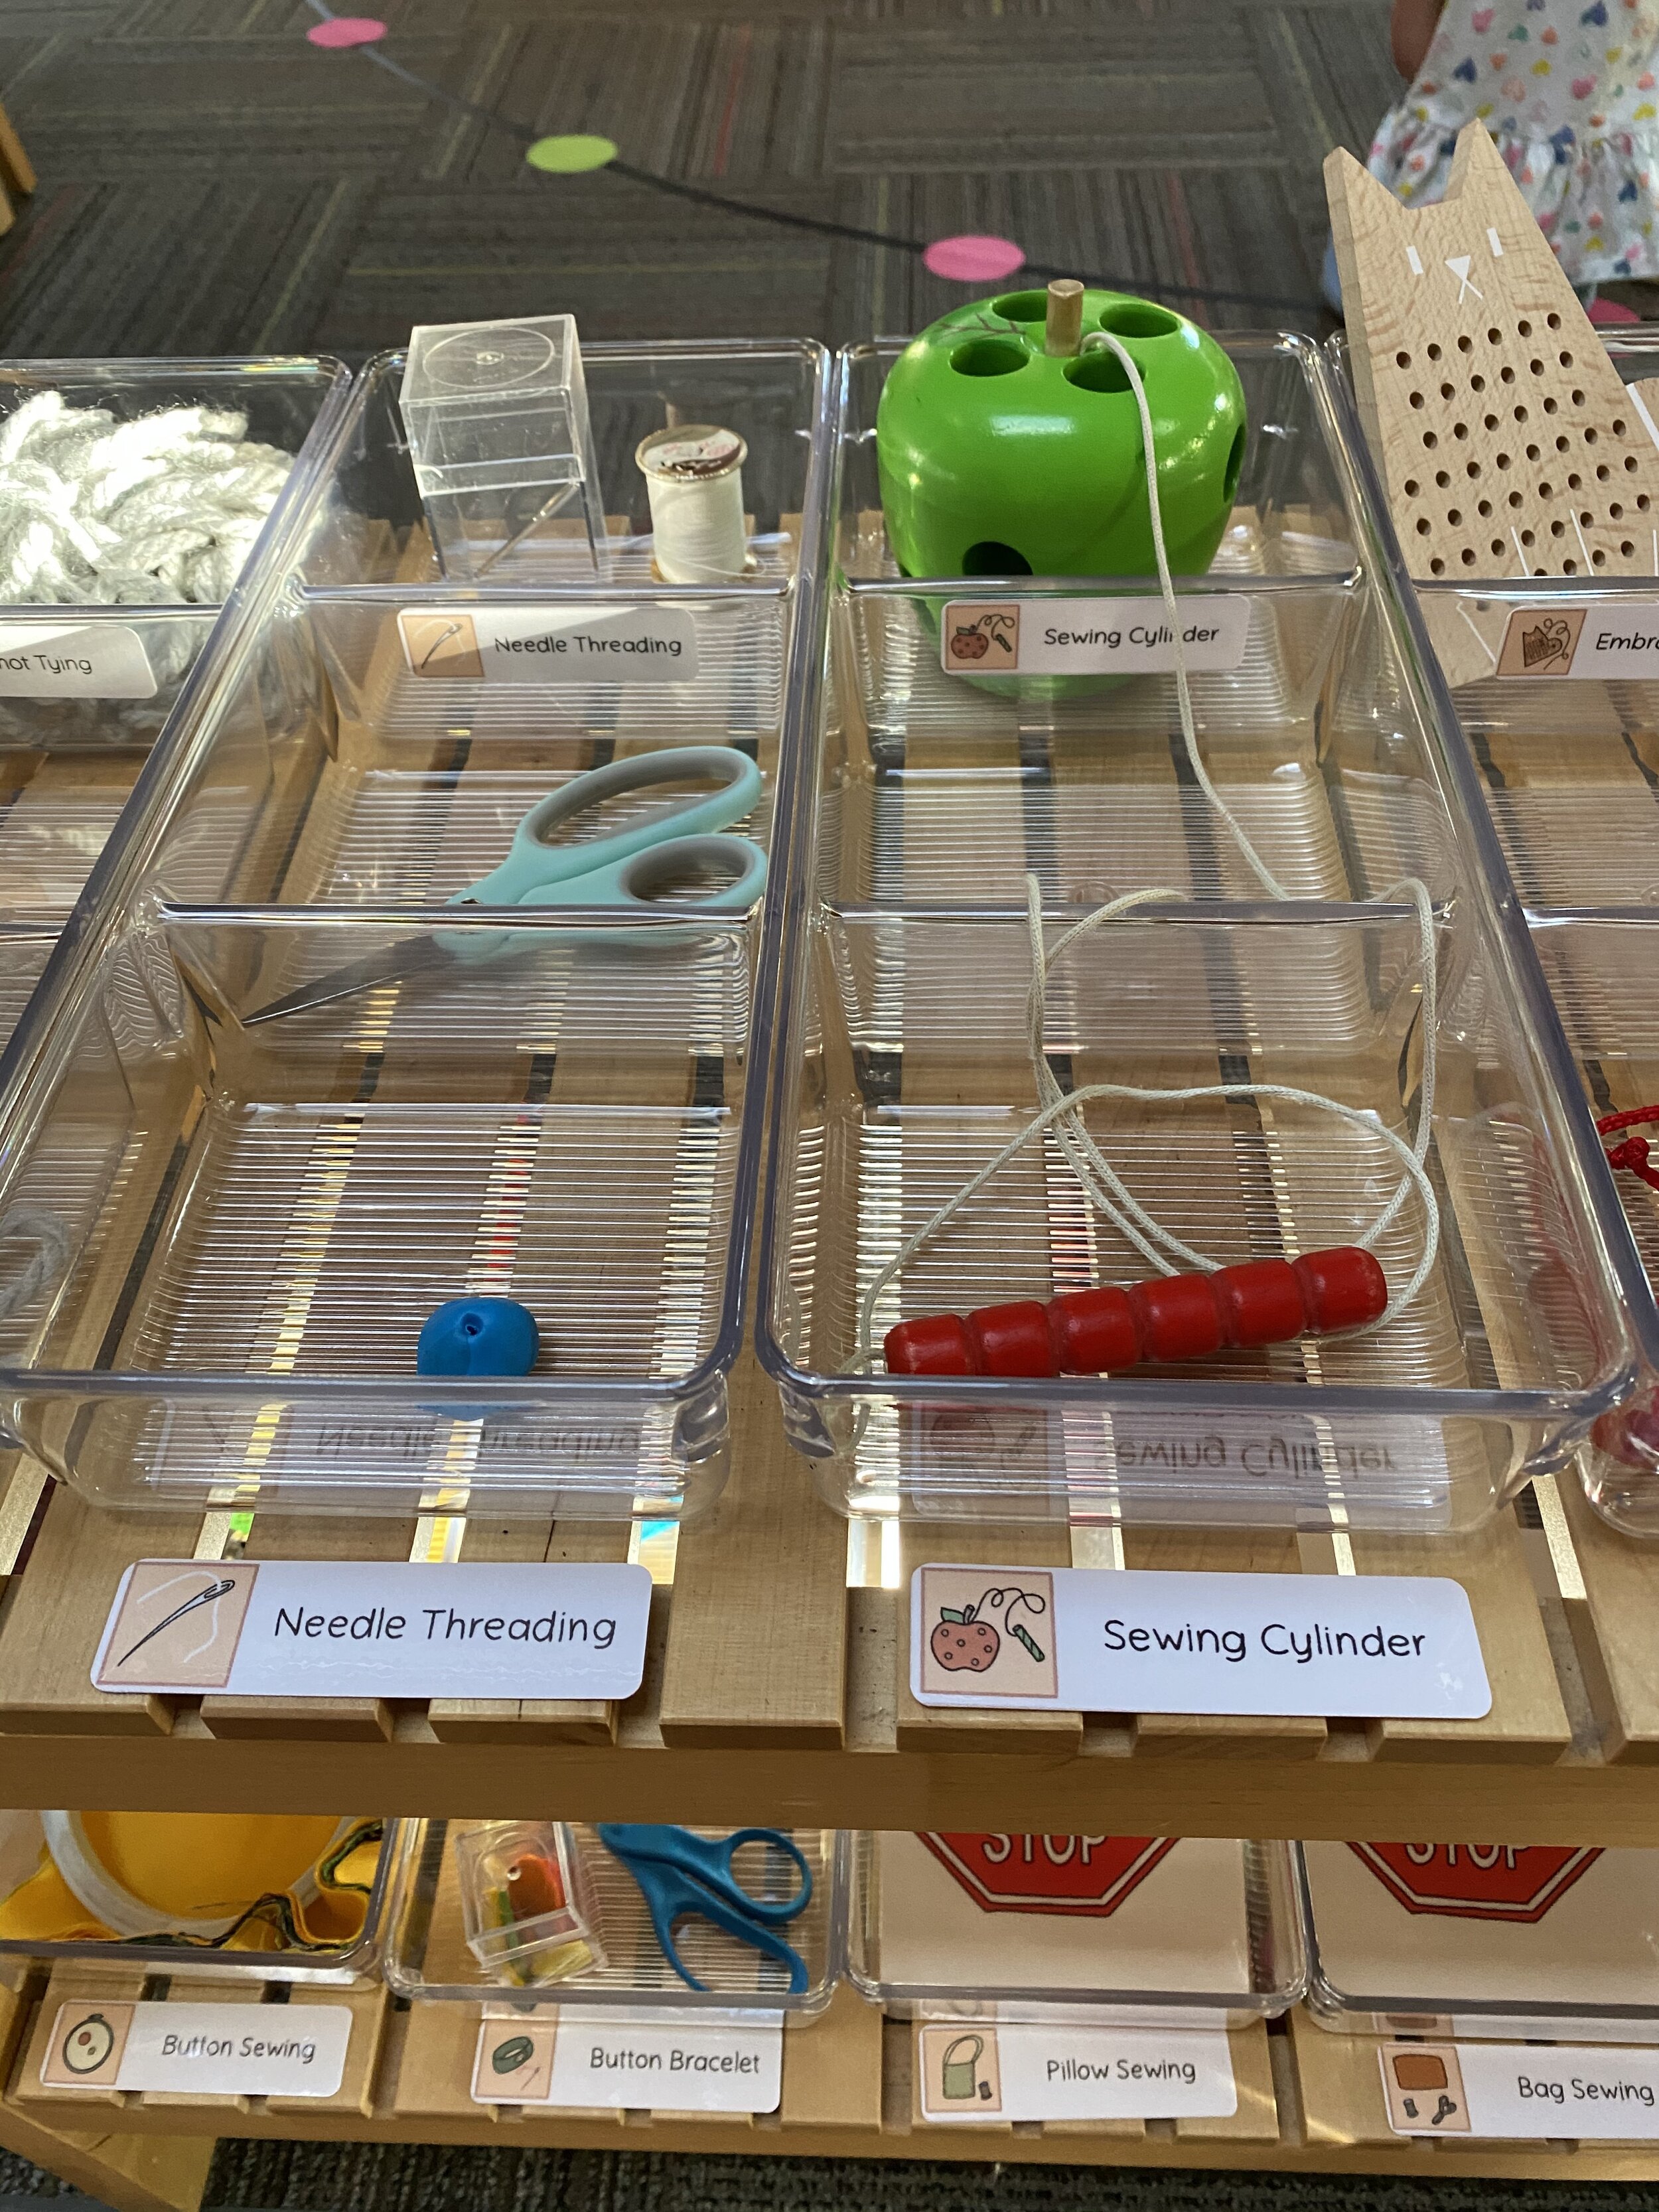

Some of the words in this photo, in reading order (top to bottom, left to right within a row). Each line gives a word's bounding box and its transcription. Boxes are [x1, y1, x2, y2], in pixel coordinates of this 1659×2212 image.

[494, 636, 567, 653] Needle
[573, 636, 682, 656] Threading
[1044, 628, 1121, 648] Sewing
[33, 654, 92, 675] Tying
[274, 1606, 407, 1639] Needle
[422, 1608, 616, 1649] Threading
[1104, 1619, 1246, 1662] Sewing
[1260, 1623, 1425, 1664] Cylinder
[161, 2033, 232, 2057] Button
[239, 2036, 316, 2065] Sewing
[589, 2046, 662, 2069] Button
[669, 2049, 760, 2073] Bracelet
[1046, 2058, 1109, 2081] Pillow
[1116, 2059, 1196, 2085] Sewing
[1518, 2075, 1565, 2104] Bag
[1571, 2077, 1655, 2106] Sewing
